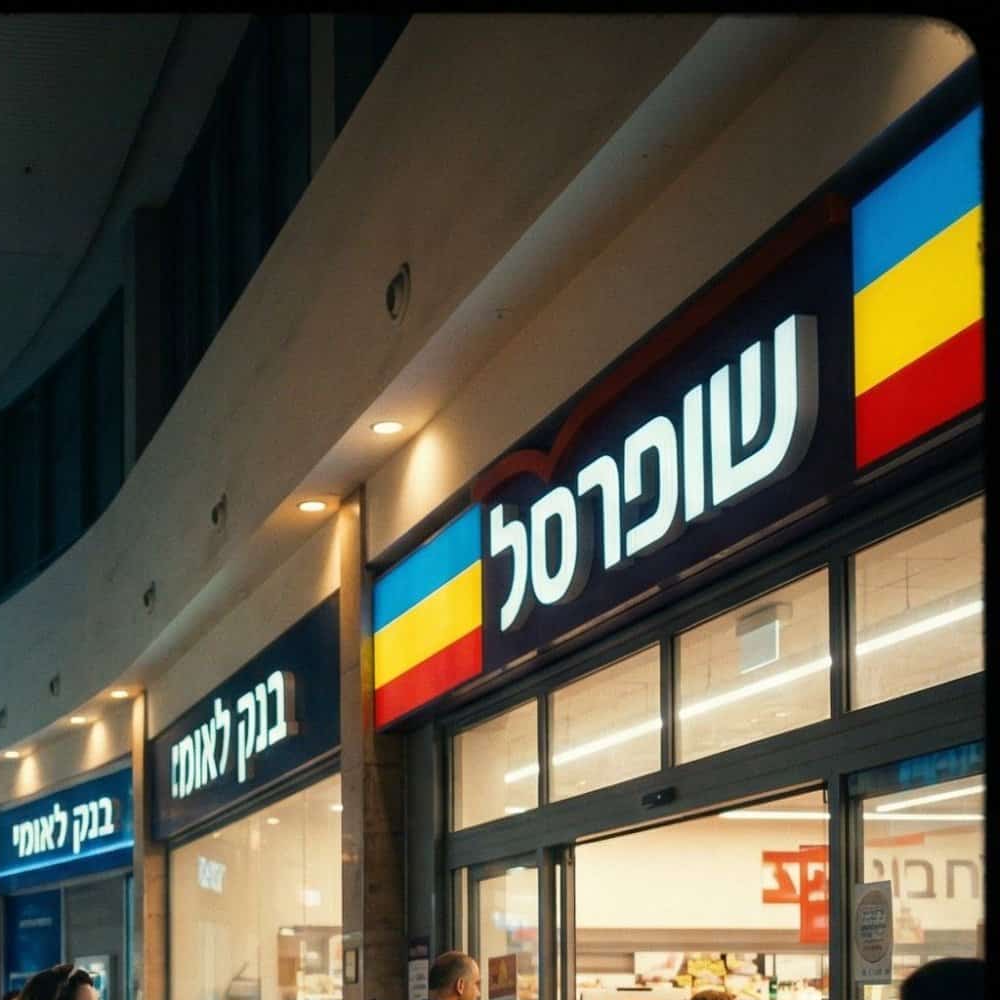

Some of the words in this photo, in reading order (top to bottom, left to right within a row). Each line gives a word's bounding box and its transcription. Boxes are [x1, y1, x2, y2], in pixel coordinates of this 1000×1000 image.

[490, 313, 802, 633] שופרסל
[236, 669, 292, 784] בנק
[12, 802, 68, 858] לאומי
[72, 796, 116, 855] בנק
